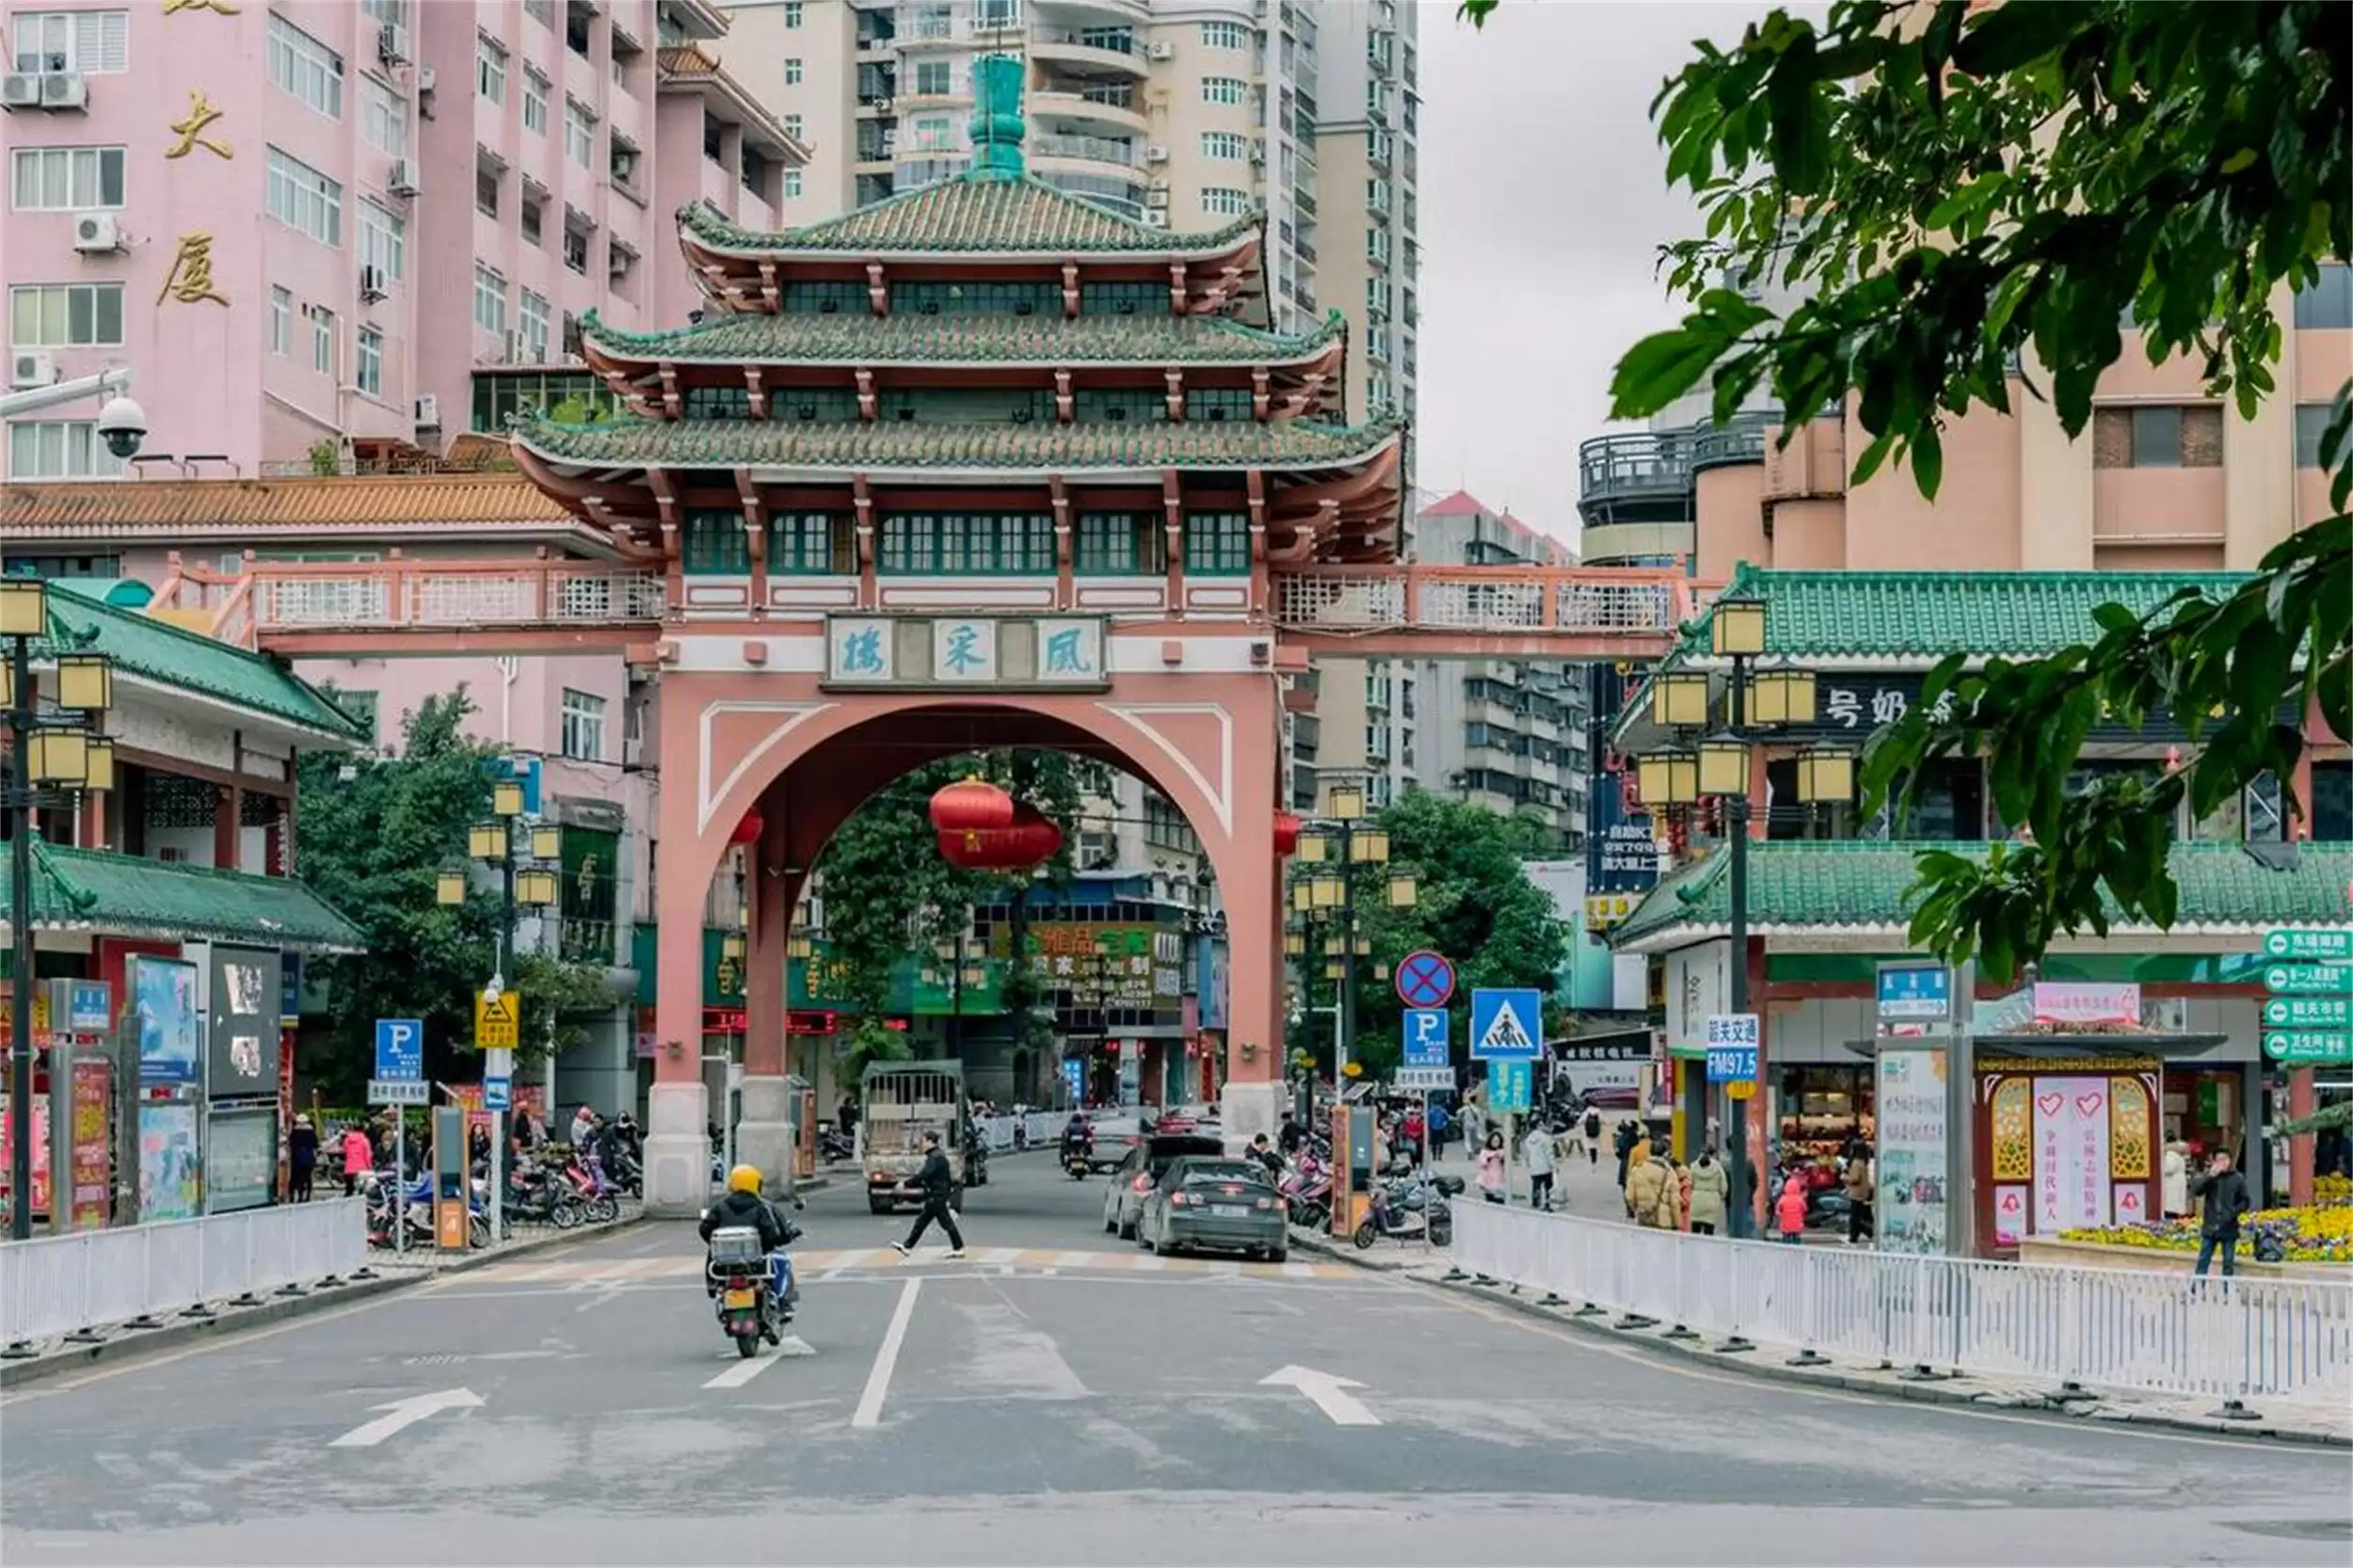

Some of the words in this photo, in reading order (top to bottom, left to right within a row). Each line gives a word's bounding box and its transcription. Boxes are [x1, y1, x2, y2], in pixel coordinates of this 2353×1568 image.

[157, 0, 242, 307] 大厦
[388, 1024, 412, 1054] P
[1416, 1013, 1438, 1042] P
[1707, 1052, 1756, 1075] FM97.5
